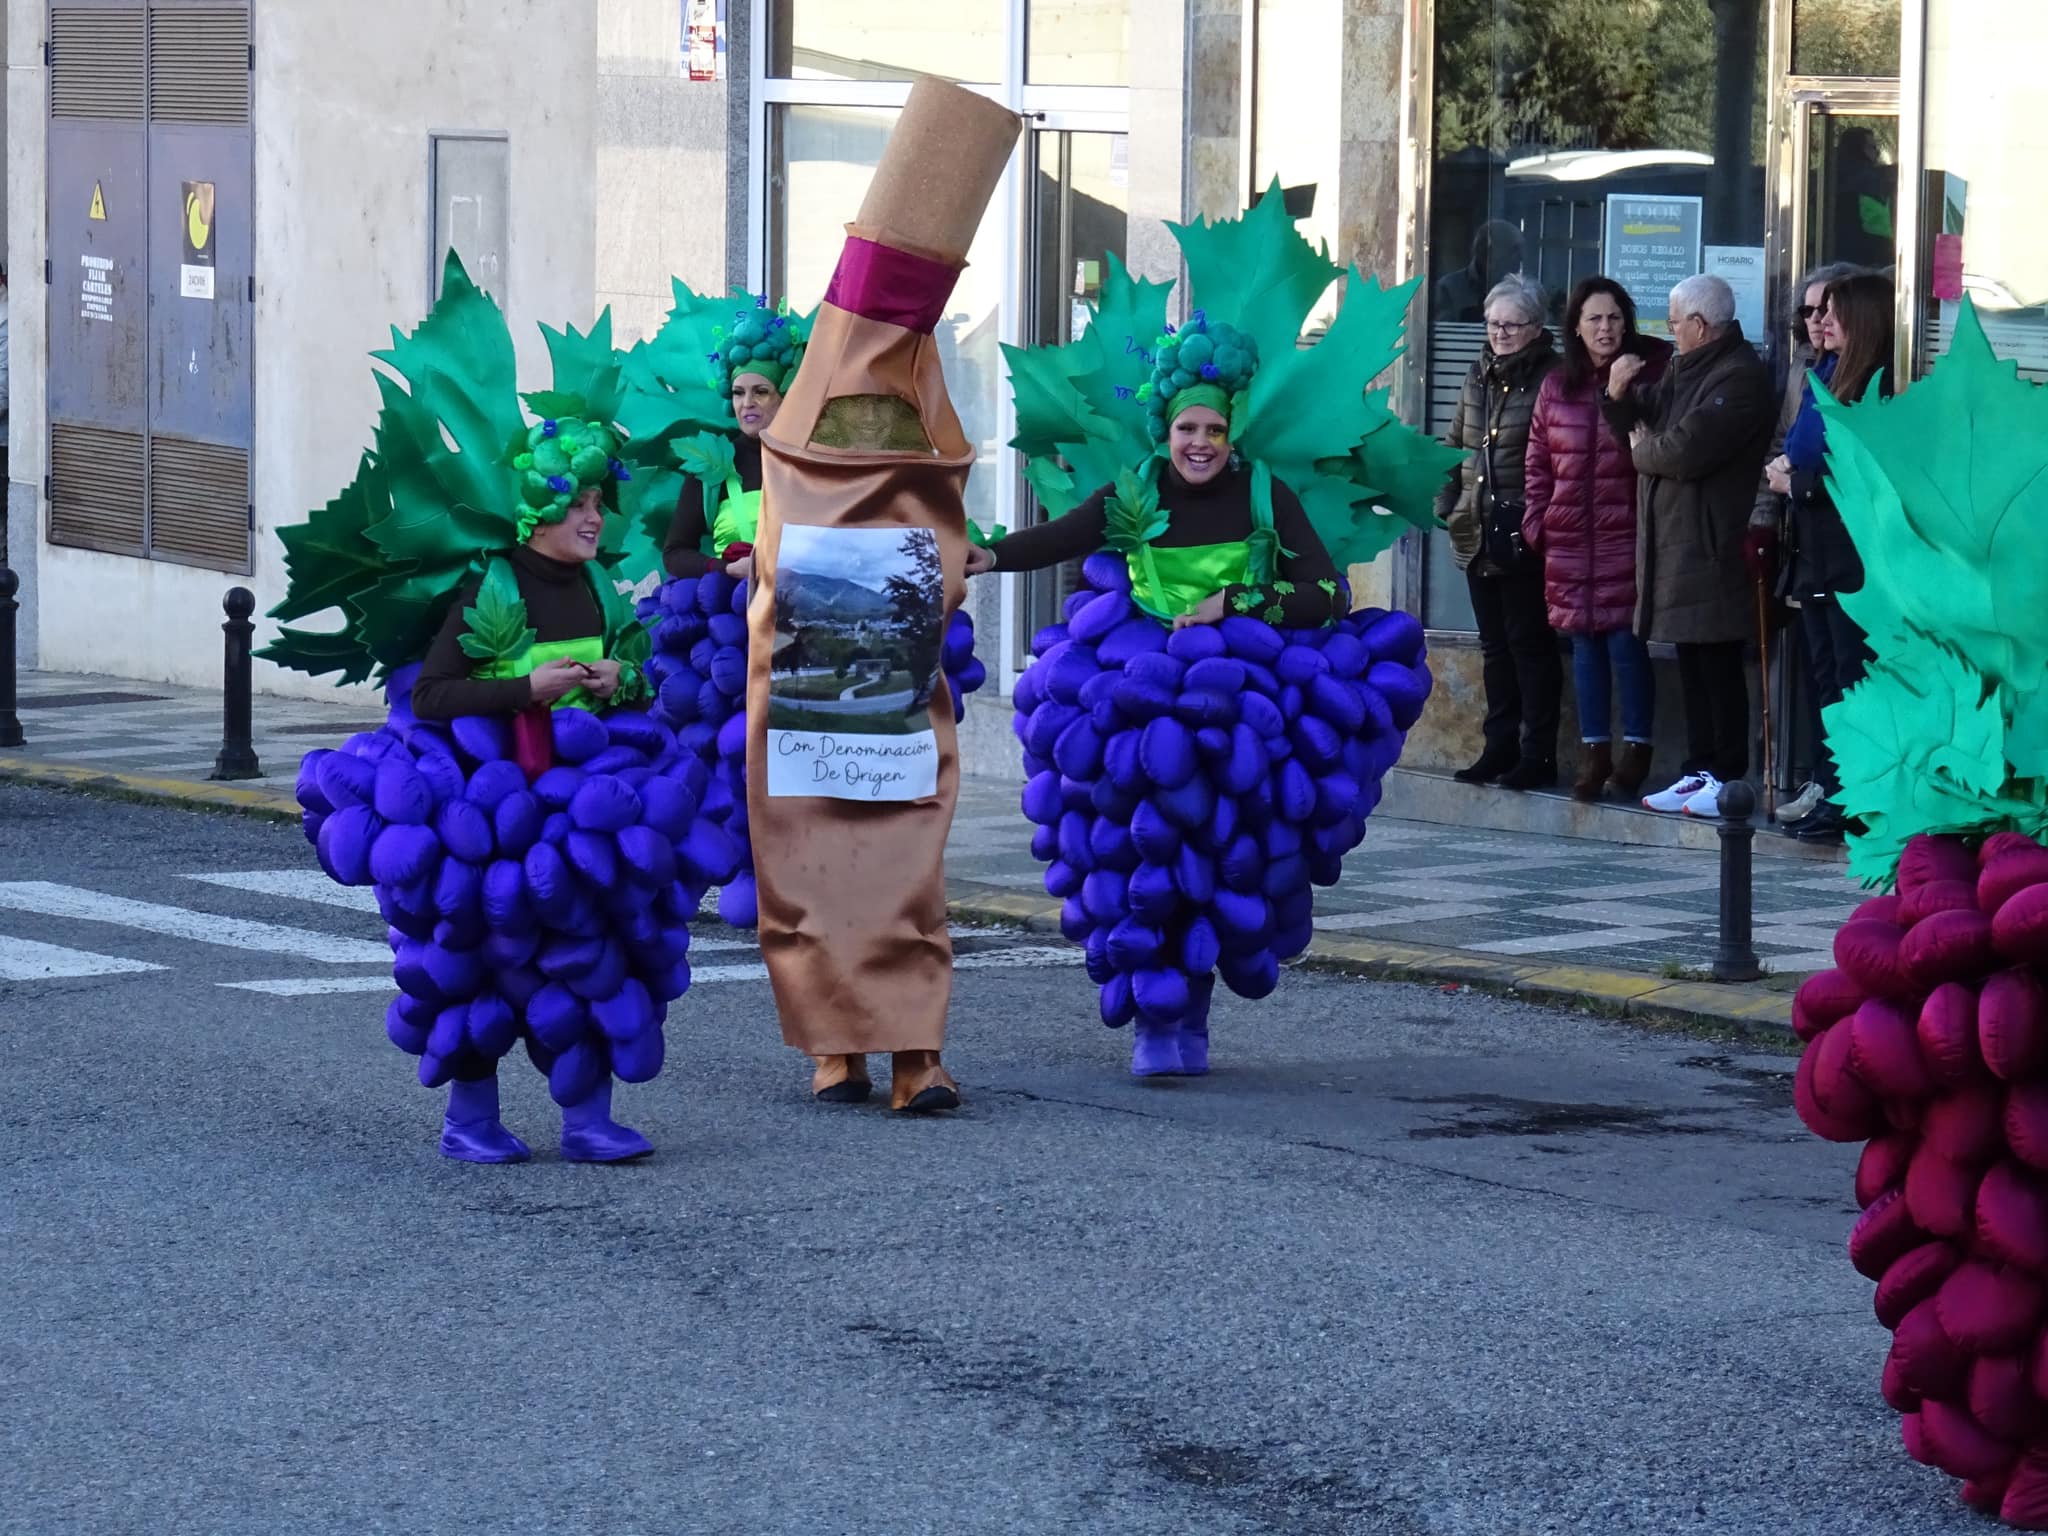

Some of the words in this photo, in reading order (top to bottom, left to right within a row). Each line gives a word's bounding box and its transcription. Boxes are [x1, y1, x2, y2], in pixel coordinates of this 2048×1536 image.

[1624, 203, 1681, 220] LOOK
[1621, 245, 1647, 254] BONOS
[1651, 246, 1685, 256] REGALO
[81, 255, 113, 271] PROHIBIDO
[1619, 260, 1640, 268] para
[1643, 259, 1687, 269] obsequiar
[1718, 256, 1754, 265] HORARIO
[1625, 272, 1649, 280] quien
[82, 281, 112, 296] CARTELES
[778, 732, 815, 756] Con
[819, 735, 933, 759] Denominación
[811, 759, 841, 782] De
[844, 761, 907, 797] Origen
